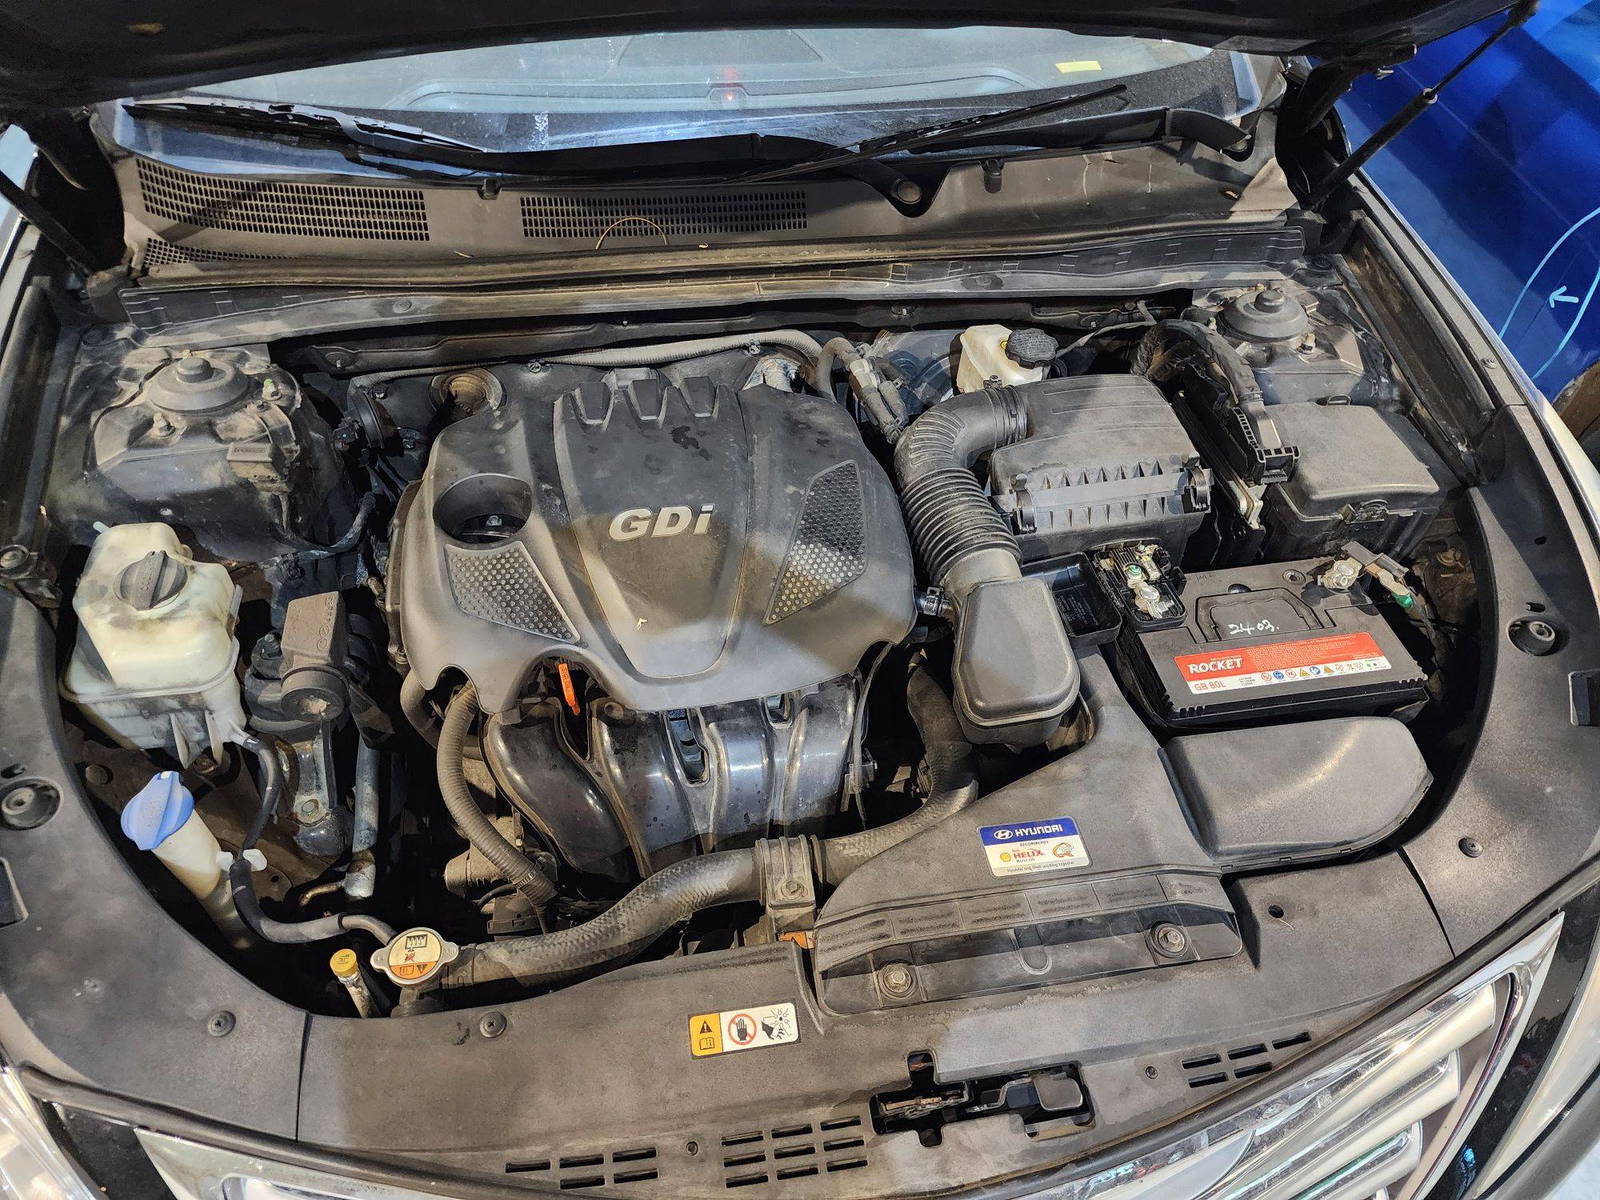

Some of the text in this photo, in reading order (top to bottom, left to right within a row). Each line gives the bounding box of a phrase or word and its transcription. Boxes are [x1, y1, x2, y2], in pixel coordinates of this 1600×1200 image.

[609, 503, 715, 542] GDi
[1187, 658, 1243, 675] ROCKET
[1015, 823, 1064, 837] HYUNDAI
